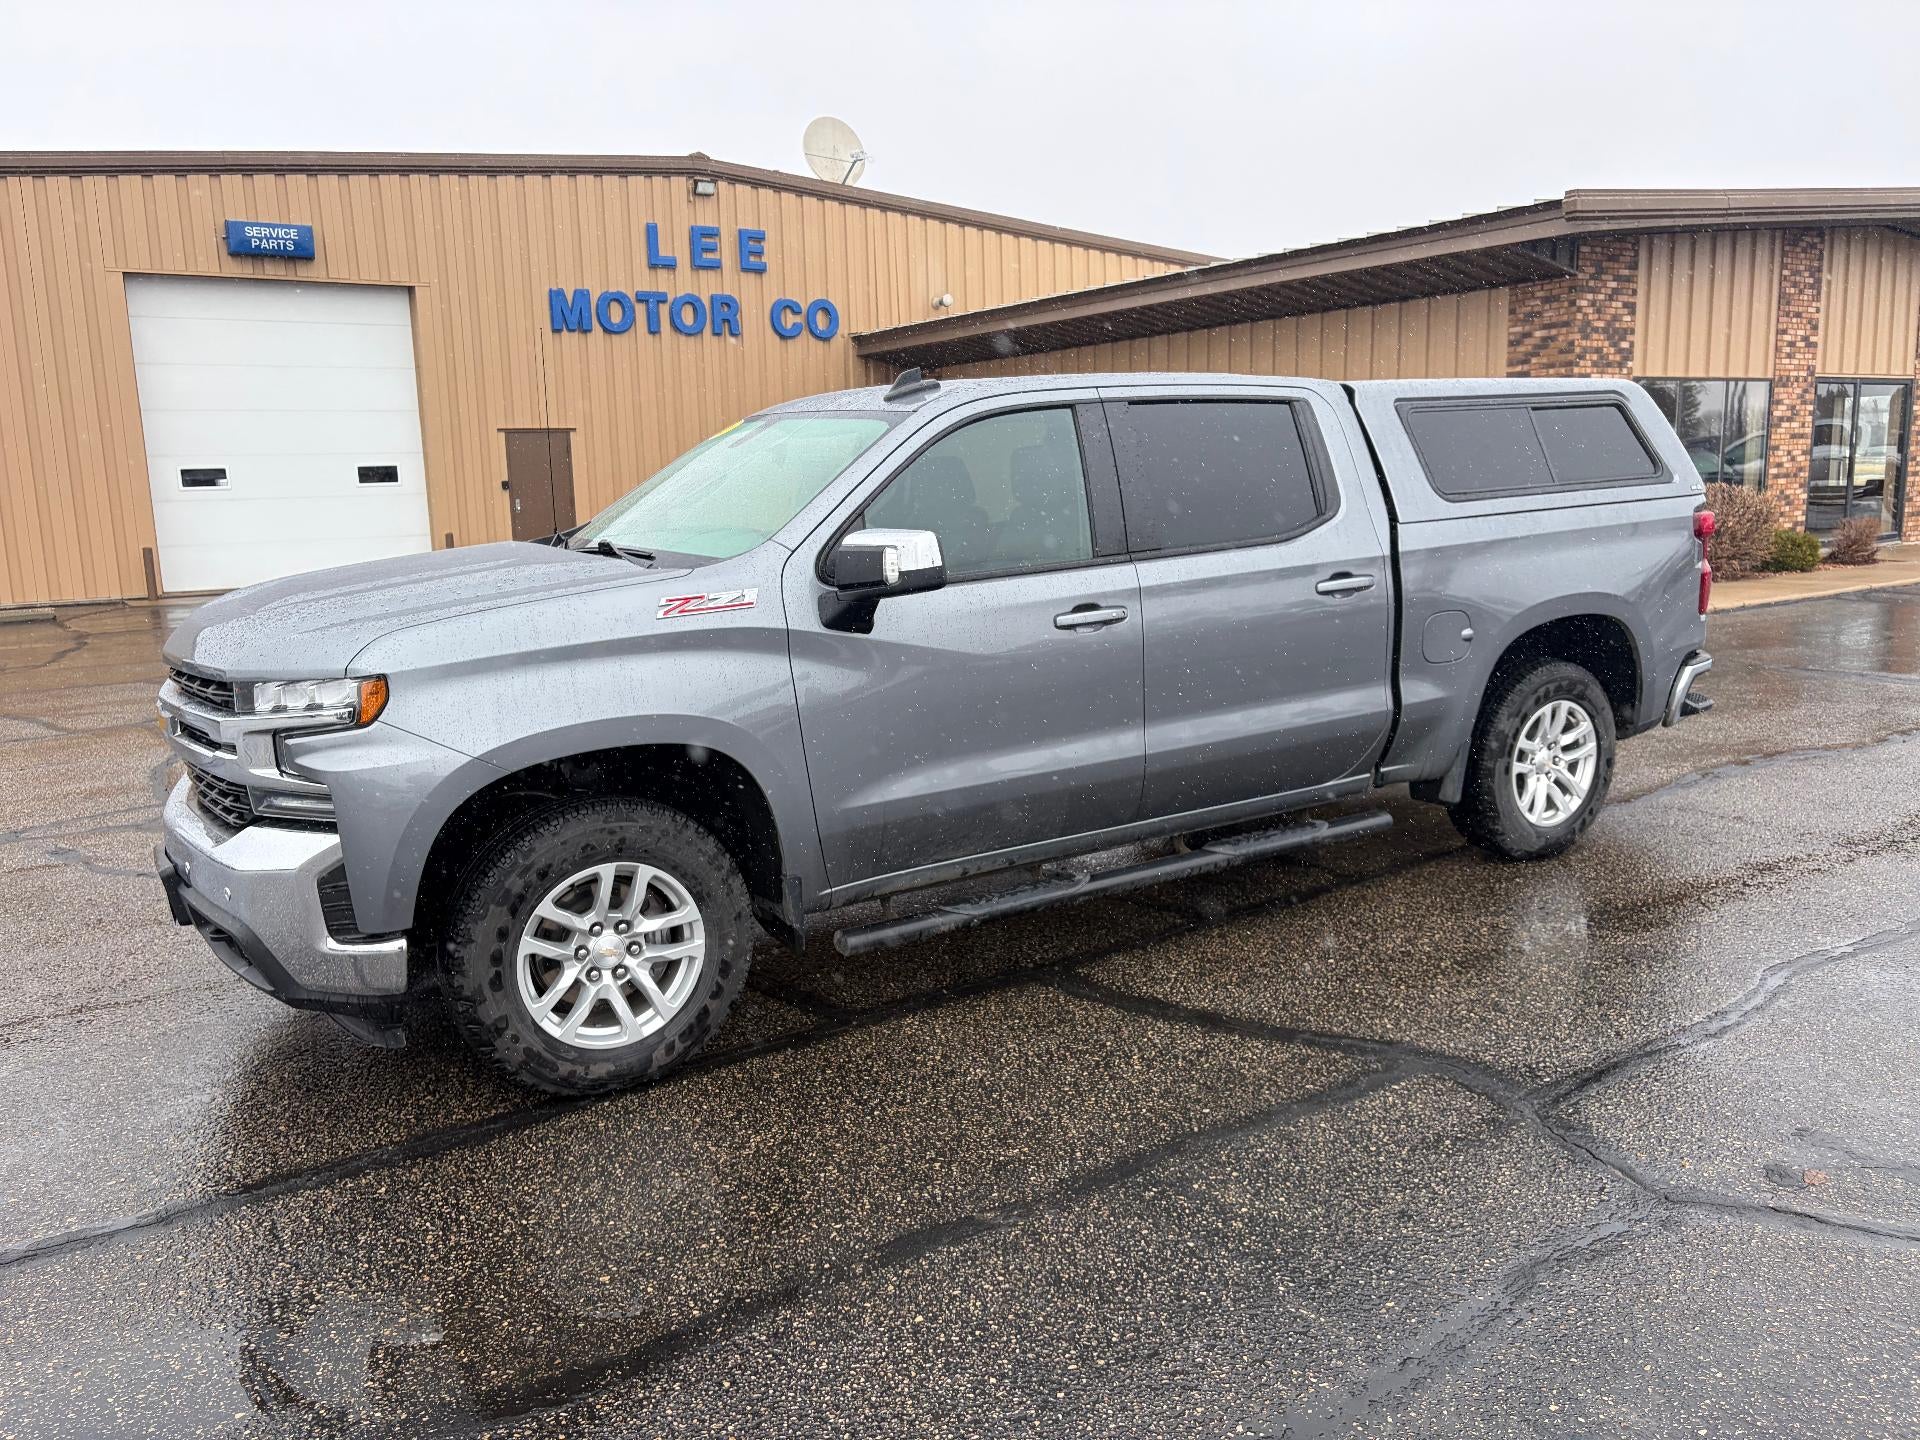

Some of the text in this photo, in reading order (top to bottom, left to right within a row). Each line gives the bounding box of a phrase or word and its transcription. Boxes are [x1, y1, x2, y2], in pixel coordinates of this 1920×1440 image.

[244, 226, 299, 239] SERVICE
[251, 238, 295, 251] PARTS
[646, 222, 767, 273] LEE
[549, 288, 840, 341] MOTOR CO
[656, 588, 758, 619] Z71
